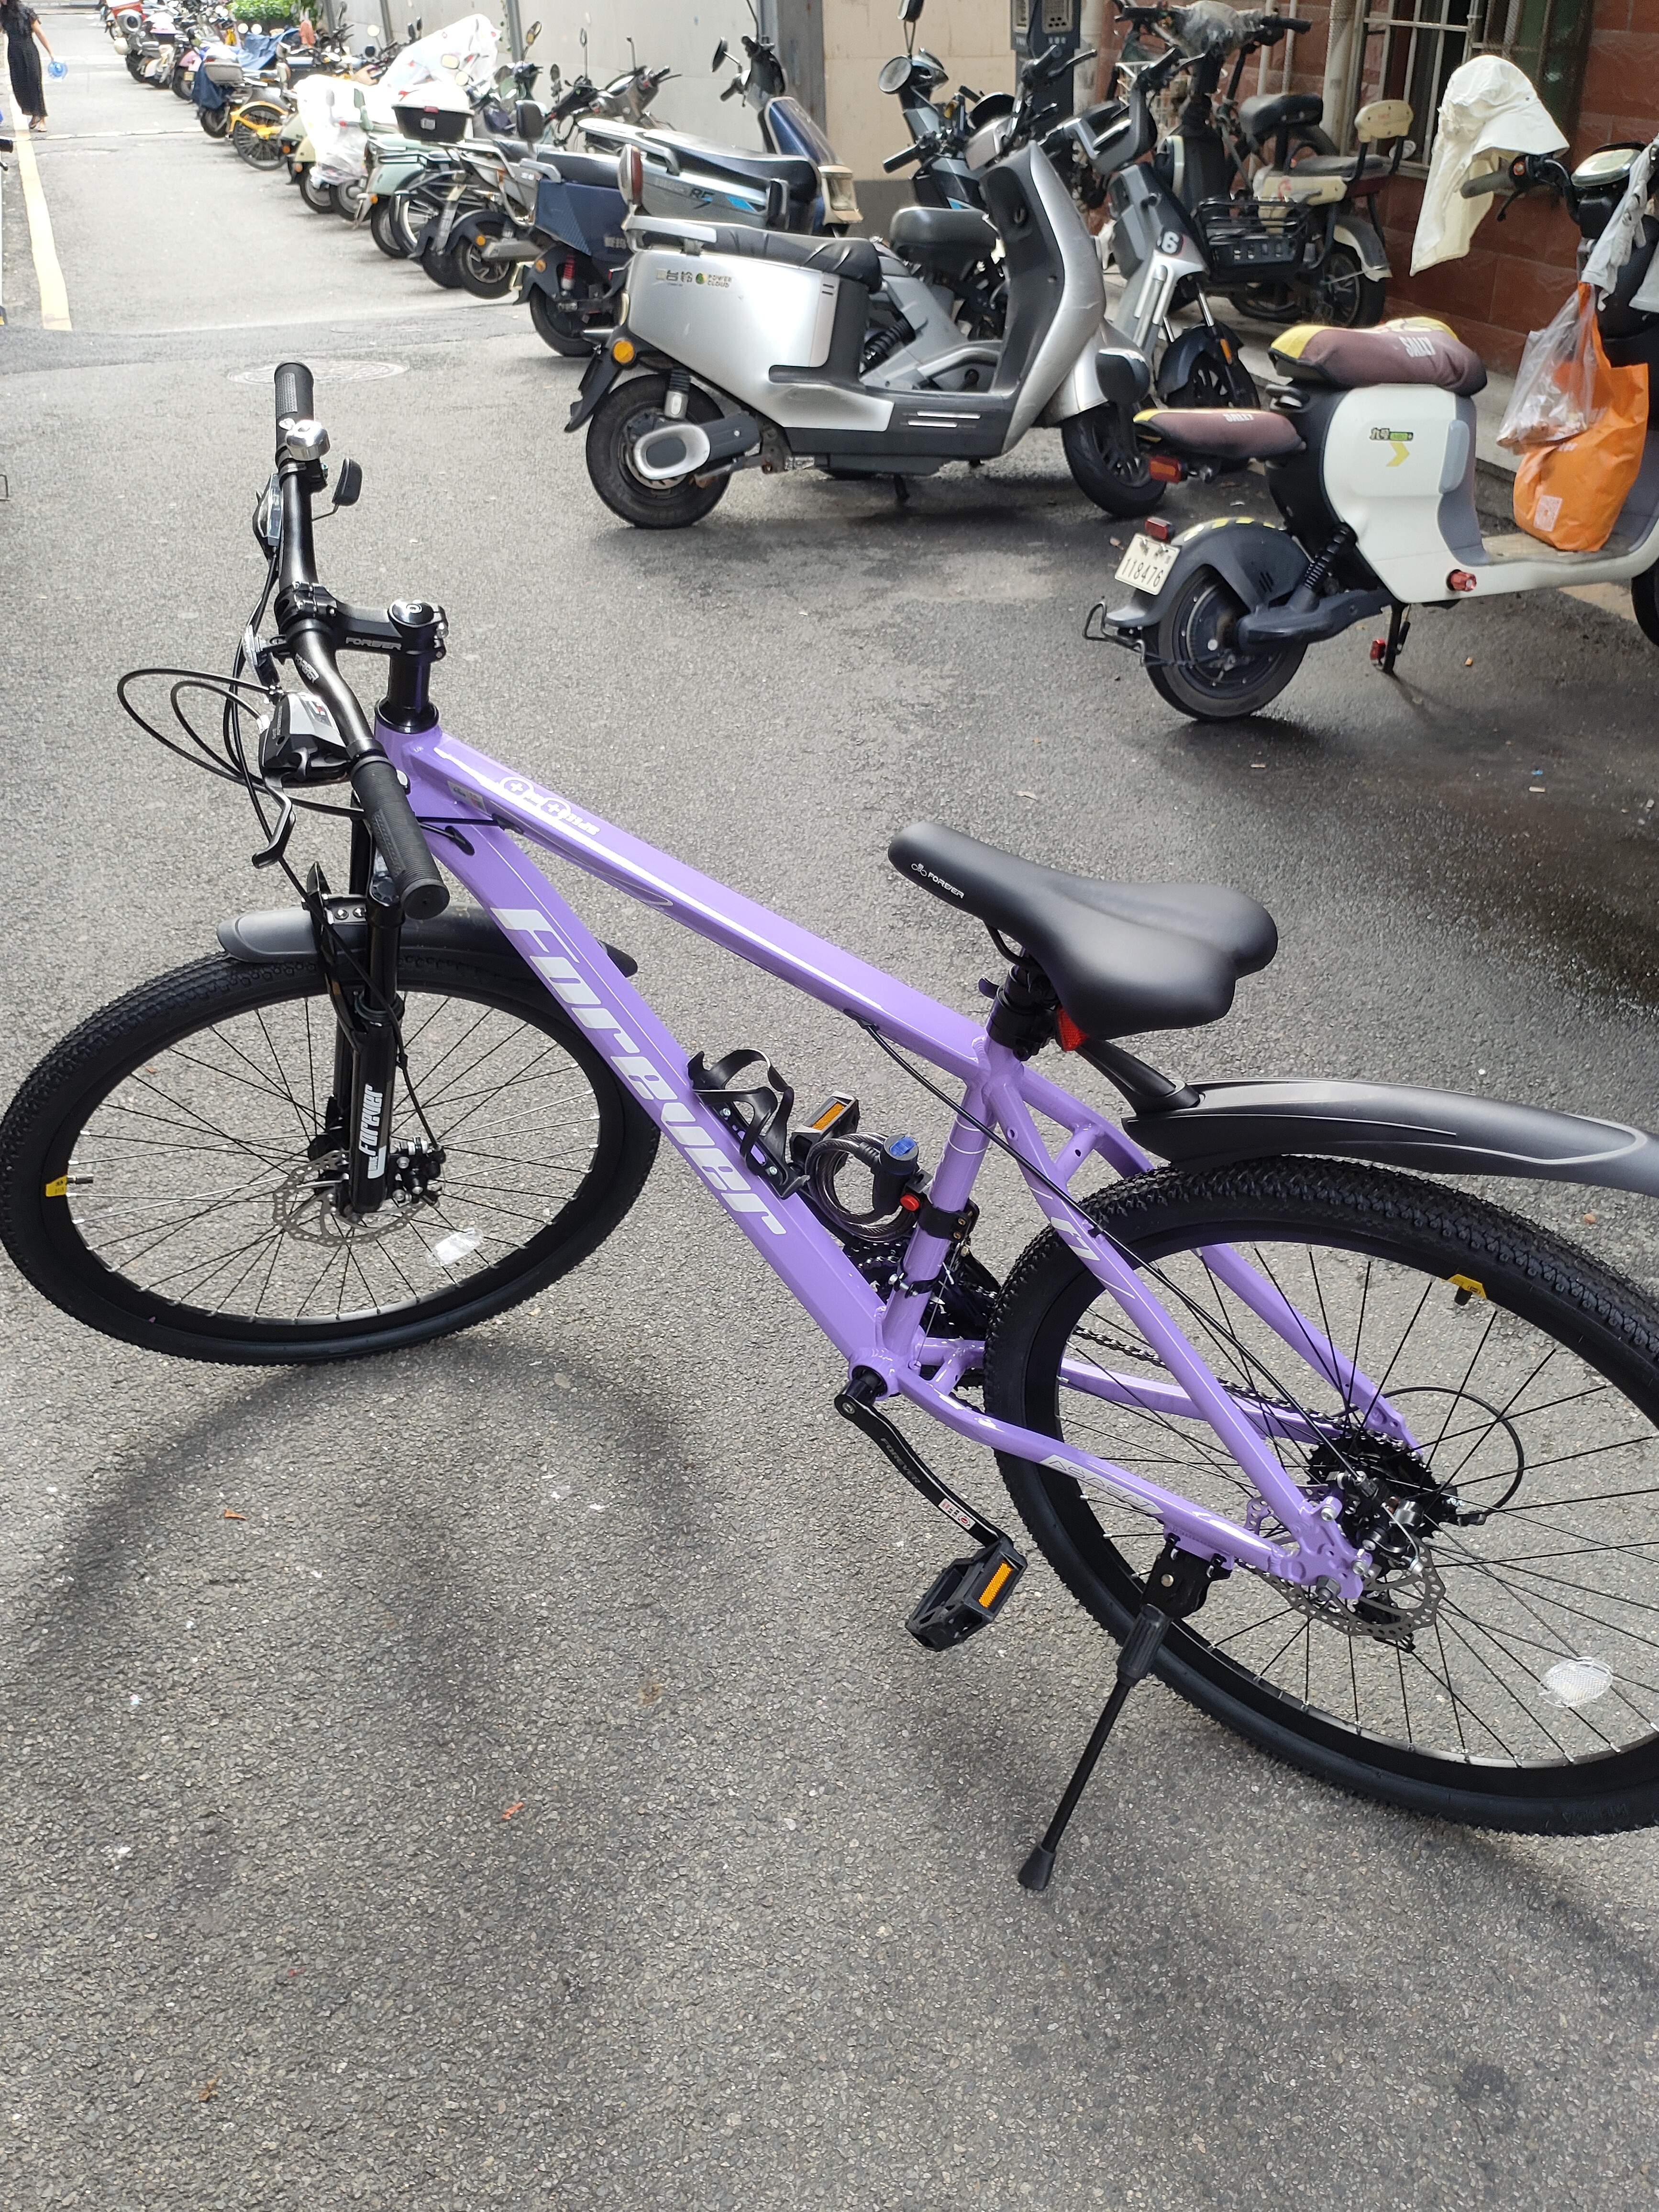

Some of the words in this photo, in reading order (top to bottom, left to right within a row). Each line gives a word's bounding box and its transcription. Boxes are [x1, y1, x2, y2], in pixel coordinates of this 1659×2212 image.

[1398, 336, 1436, 358] SALLY
[1121, 558, 1164, 588] 118476
[879, 1438, 921, 1484] FOREVER
